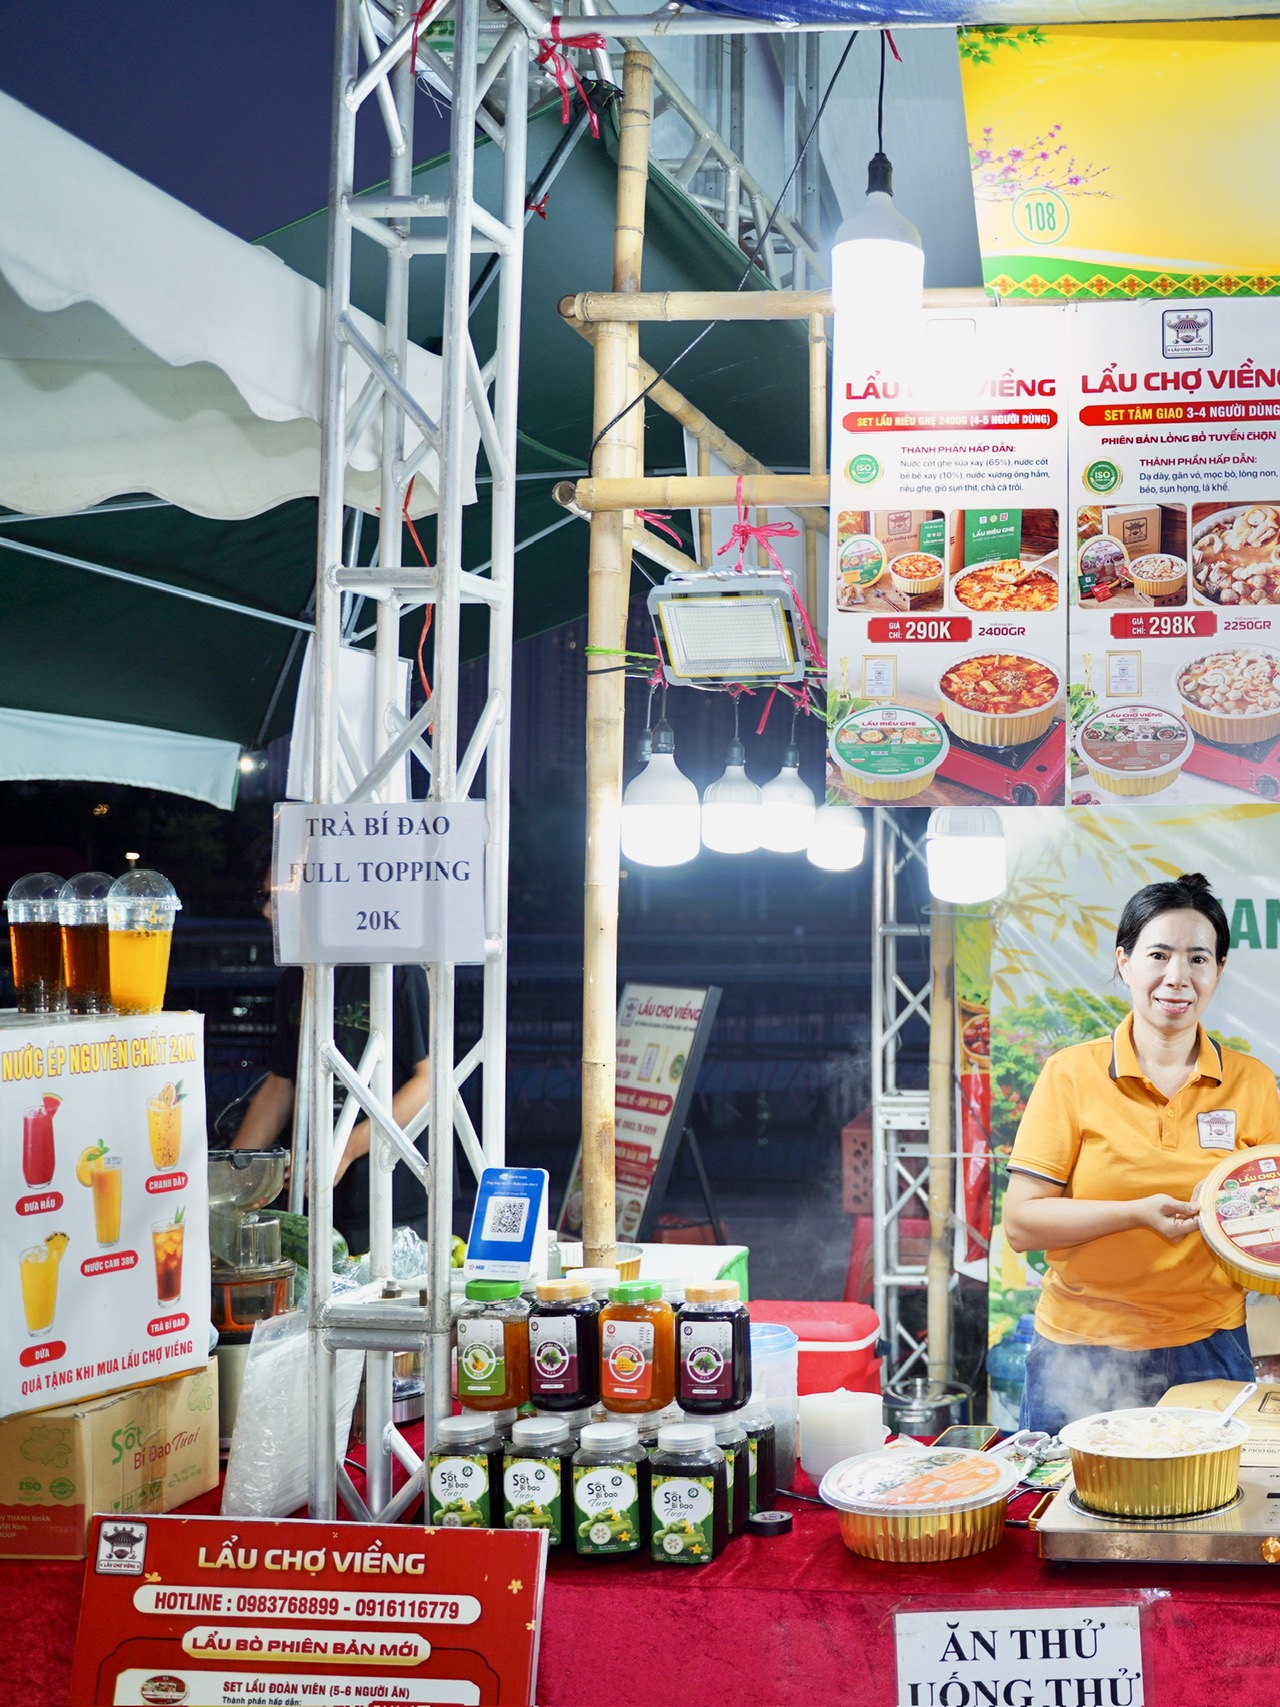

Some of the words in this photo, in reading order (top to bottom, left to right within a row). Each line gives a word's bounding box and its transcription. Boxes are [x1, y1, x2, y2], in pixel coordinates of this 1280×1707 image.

[1023, 202, 1058, 233] 108
[1082, 363, 1137, 394] LẨU
[1144, 367, 1202, 395] CHỢ
[905, 621, 952, 641] 290K
[978, 626, 1026, 637] 2400GR
[1148, 616, 1197, 637] 298K
[1223, 620, 1272, 632] 2250GR
[306, 811, 356, 837] TRÀ
[365, 811, 389, 836] BÍ
[397, 816, 451, 836] ĐAO
[289, 862, 350, 884] FULL
[357, 861, 471, 883] TOPPING
[356, 910, 401, 931] 20K
[2, 1042, 44, 1082] NƯỚC
[47, 1040, 66, 1077] ÉP
[69, 1034, 129, 1075] NGUYÊN
[169, 1033, 196, 1063] 20K
[149, 1179, 172, 1191] CHANH
[173, 1175, 186, 1187] DÂY
[24, 1201, 39, 1213] DƯA
[104, 1257, 120, 1270] CAM
[121, 1255, 135, 1267] 30K
[21, 1374, 43, 1396] QUÀ
[45, 1370, 73, 1391] TẶNG
[76, 1364, 95, 1381] KHI
[97, 1358, 119, 1377] MUA
[19, 1481, 42, 1492] ISO
[198, 1535, 258, 1569] LẨU
[264, 1546, 326, 1577] CHỢ
[332, 1539, 425, 1575] VIỀNG
[154, 1591, 223, 1612] HOTLINE
[227, 1598, 232, 1612] :
[236, 1594, 339, 1616] 0983768899
[356, 1598, 459, 1620] 0916116779
[192, 1631, 231, 1651] LẨU
[236, 1635, 263, 1652] BÒ
[268, 1636, 328, 1654] PHIÊN
[332, 1638, 375, 1656] BẢN
[380, 1640, 419, 1657] MỚI
[939, 1621, 998, 1662] ĂN
[1010, 1618, 1106, 1660] THỬ
[907, 1671, 1036, 1707] UỐNG
[1045, 1667, 1142, 1707] THỬ
